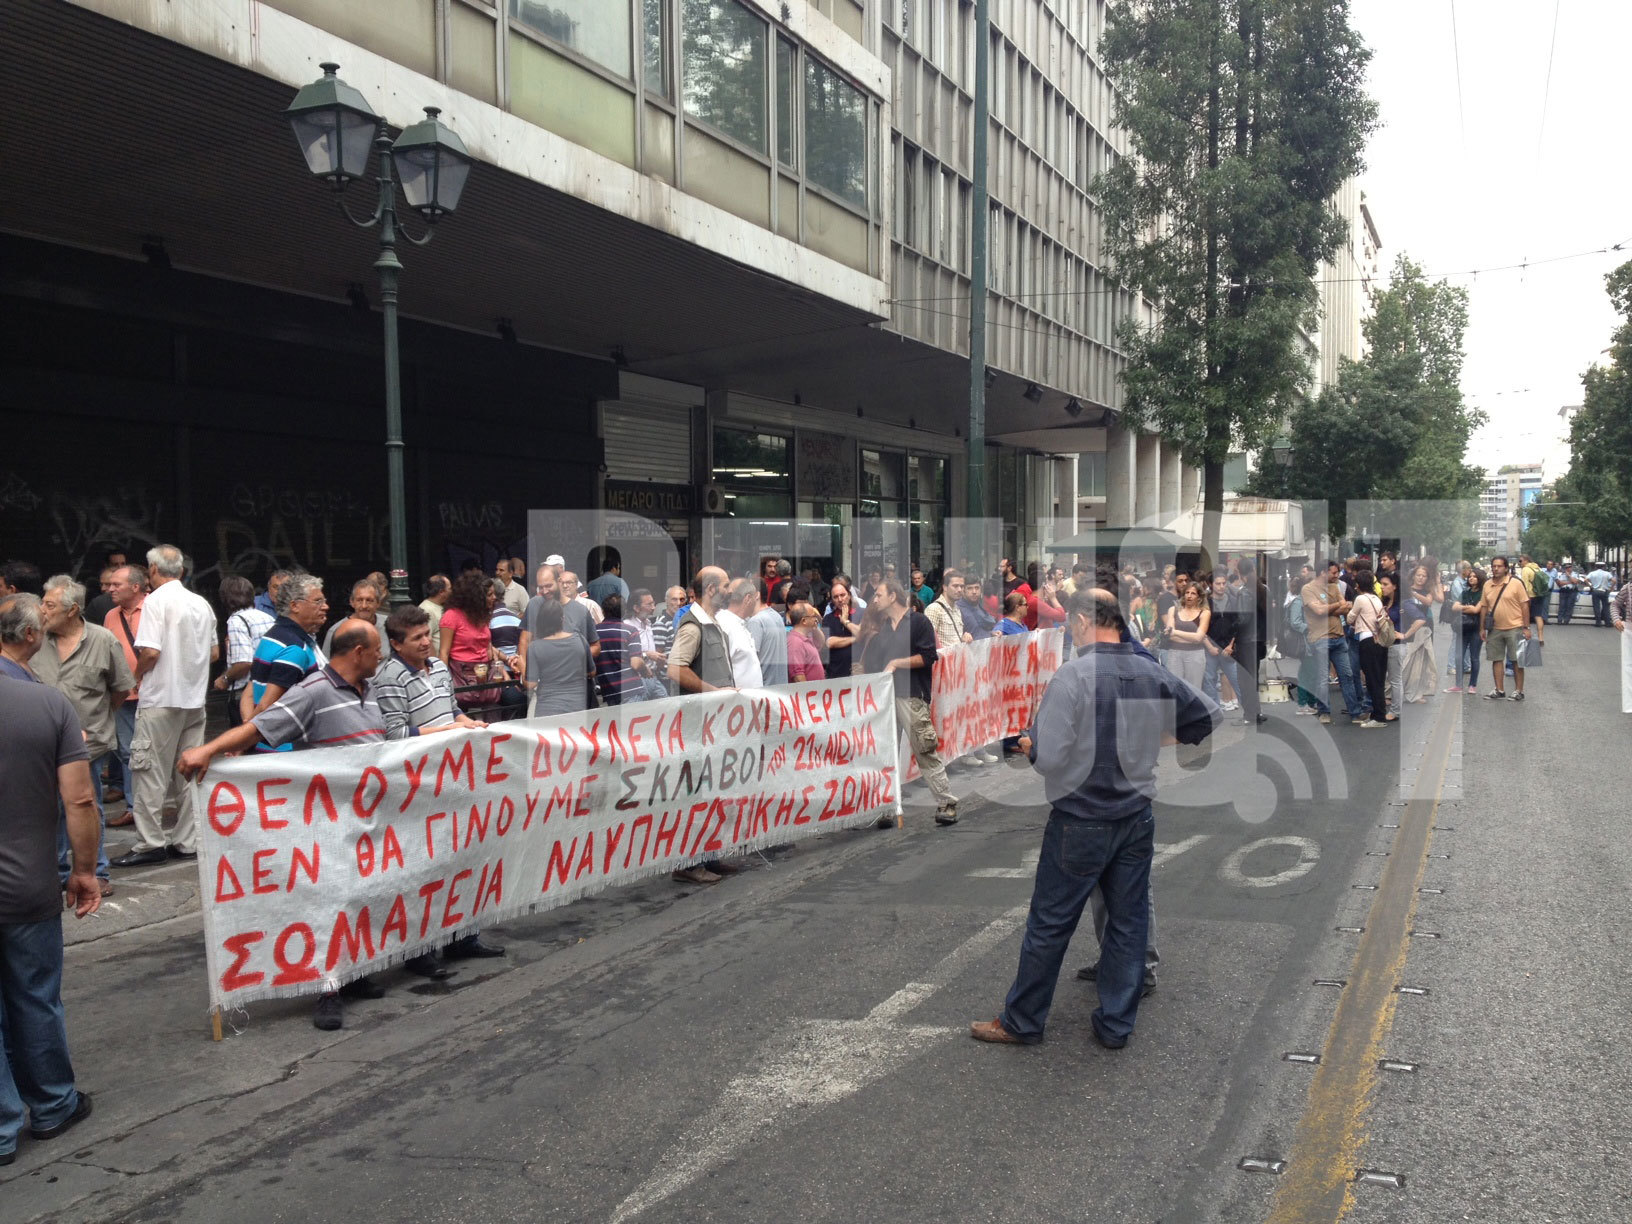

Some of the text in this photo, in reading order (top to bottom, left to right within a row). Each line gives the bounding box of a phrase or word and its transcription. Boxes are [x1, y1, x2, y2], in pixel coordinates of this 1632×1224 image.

[608, 489, 654, 509] ΜΕΓΑΡΟ
[207, 733, 512, 836] ΘΕΛΟΥΜΕ
[531, 710, 685, 779] ΔΟΥΛΕΙΑ
[778, 683, 878, 735] ΑΝΕΡΓΙΑ
[215, 841, 320, 903] ΔΕΝ
[355, 824, 404, 878] ΘΑ
[426, 774, 599, 859] ΓΙΝΟΥΜΕ
[615, 744, 765, 811] ΣΚΛΑΒΟΙ
[824, 721, 877, 767] ΑΙΩΝΑ
[220, 858, 503, 992] ΣΩΜΑΤΕΙΑ
[818, 766, 895, 821] ΖΩΝΗΣ
